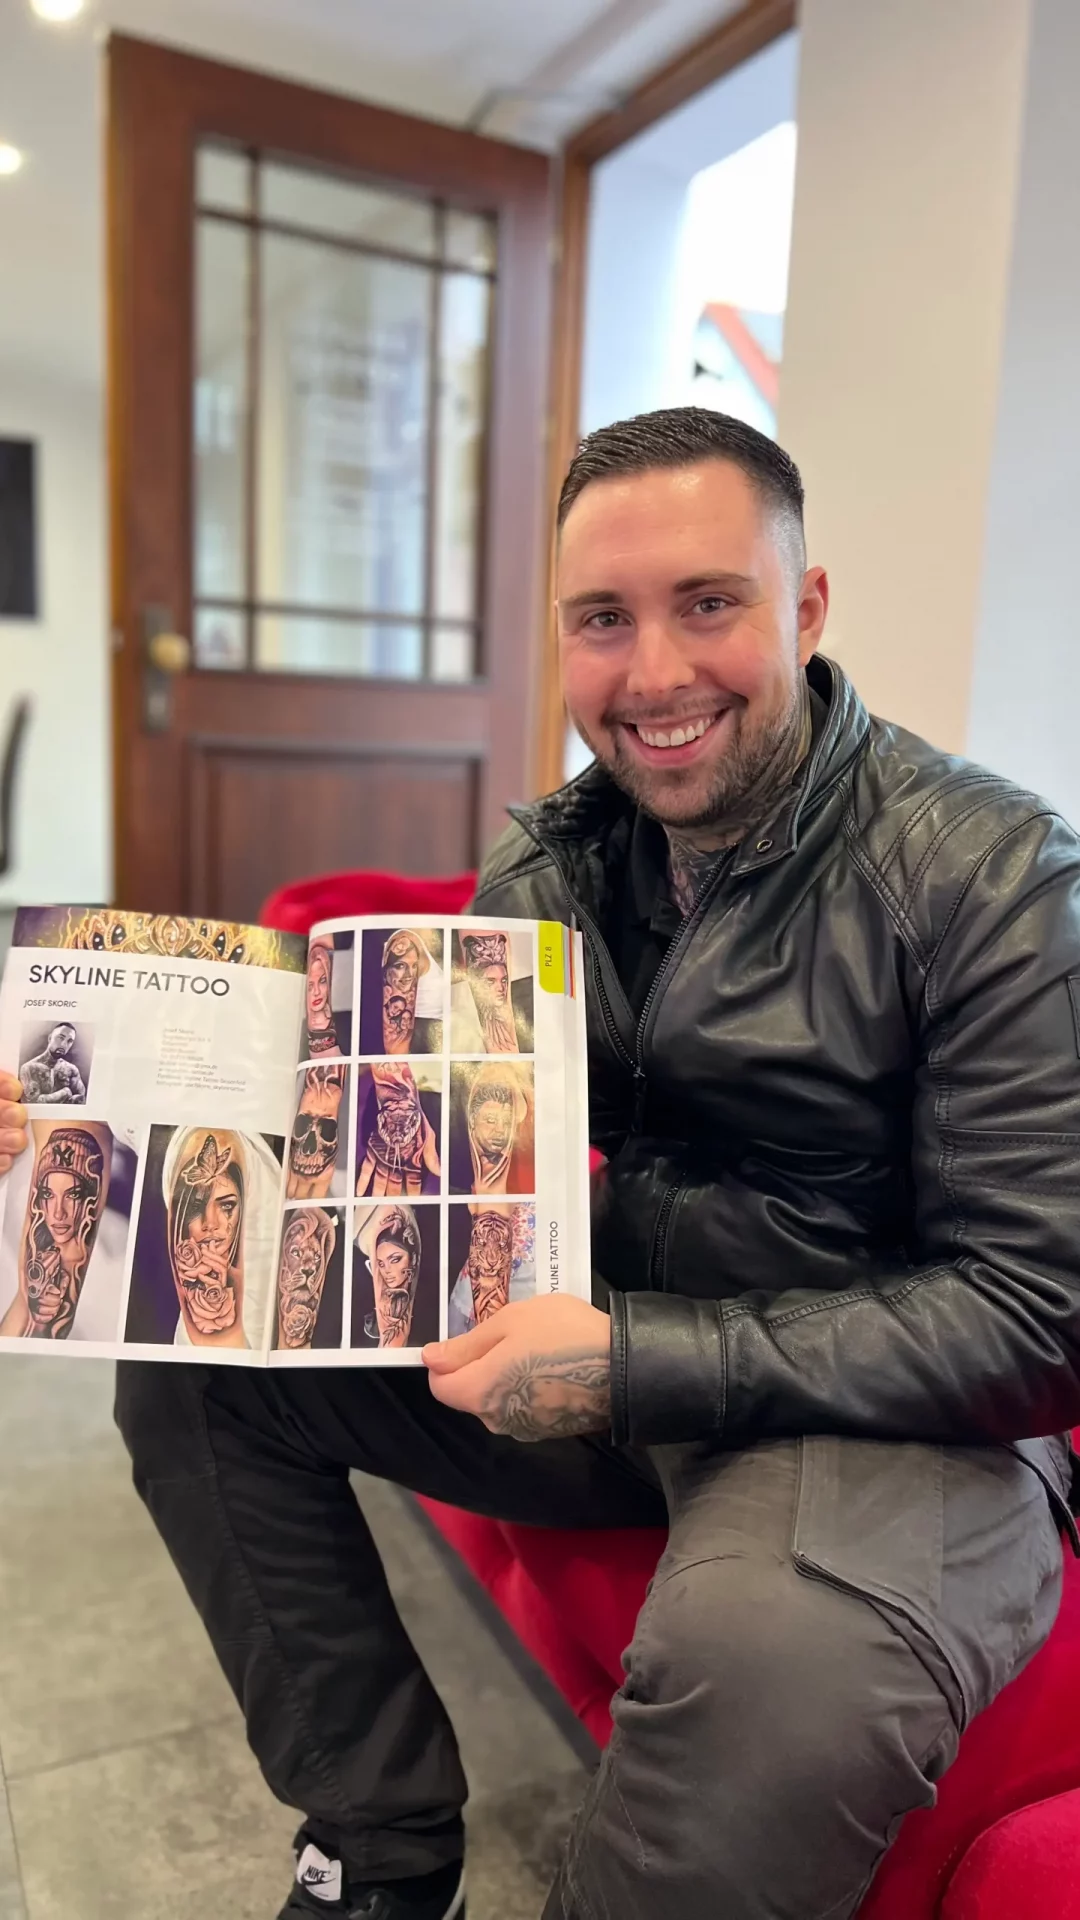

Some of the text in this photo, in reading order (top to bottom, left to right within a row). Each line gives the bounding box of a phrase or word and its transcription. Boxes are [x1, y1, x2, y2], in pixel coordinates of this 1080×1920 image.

[29, 964, 230, 997] SKYLINE TATTOO
[23, 999, 78, 1008] JOSEF SKORIC
[549, 1221, 559, 1293] YLINE TATTOO
[305, 1865, 327, 1882] NIKE
